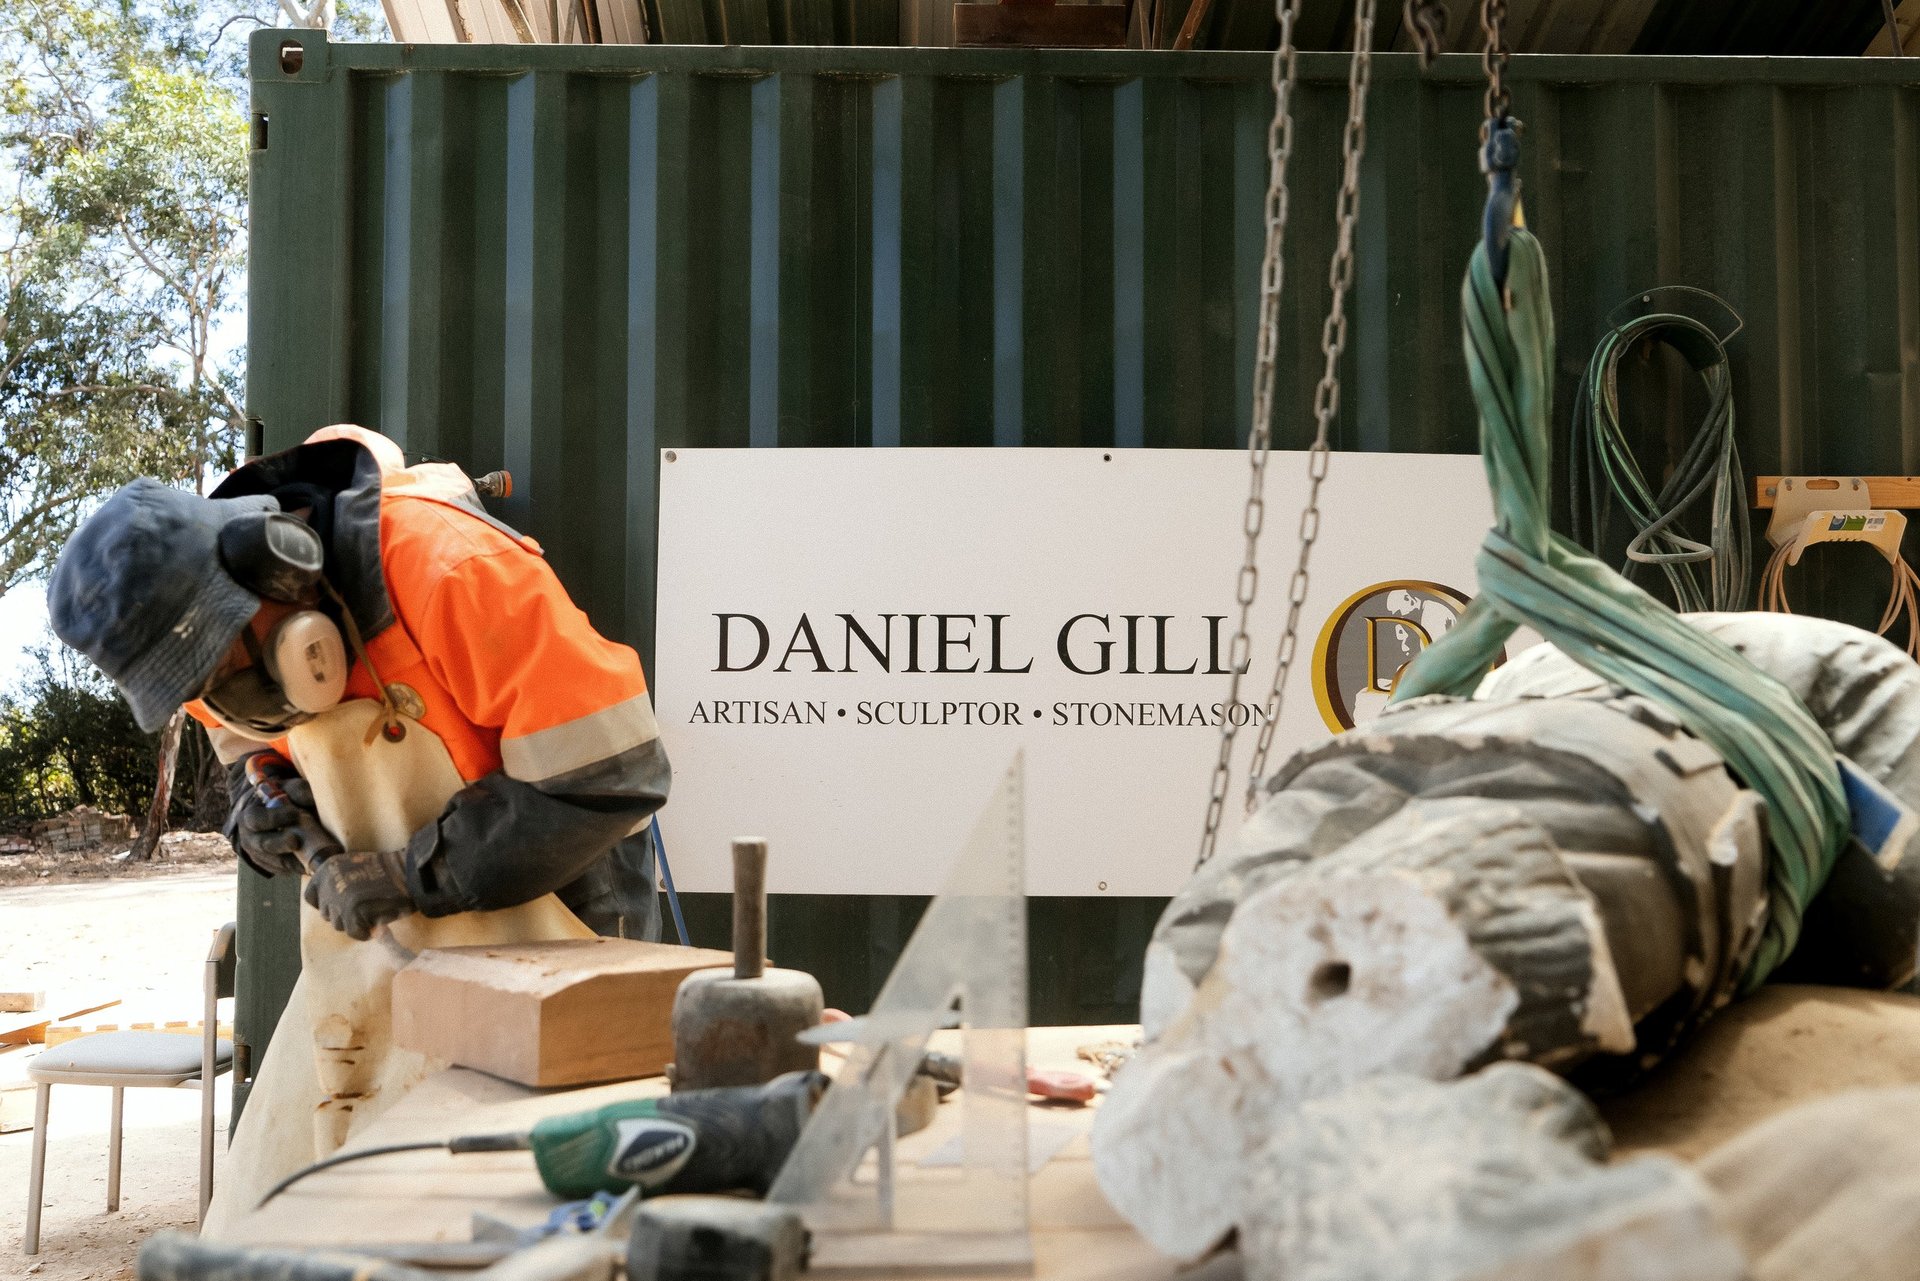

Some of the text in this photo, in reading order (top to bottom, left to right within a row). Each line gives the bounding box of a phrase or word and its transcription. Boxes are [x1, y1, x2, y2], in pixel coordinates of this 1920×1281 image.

[711, 612, 1251, 675] DANIEL GILL
[688, 700, 1274, 727] ARTISAN SCULPTOR STONEMASON
